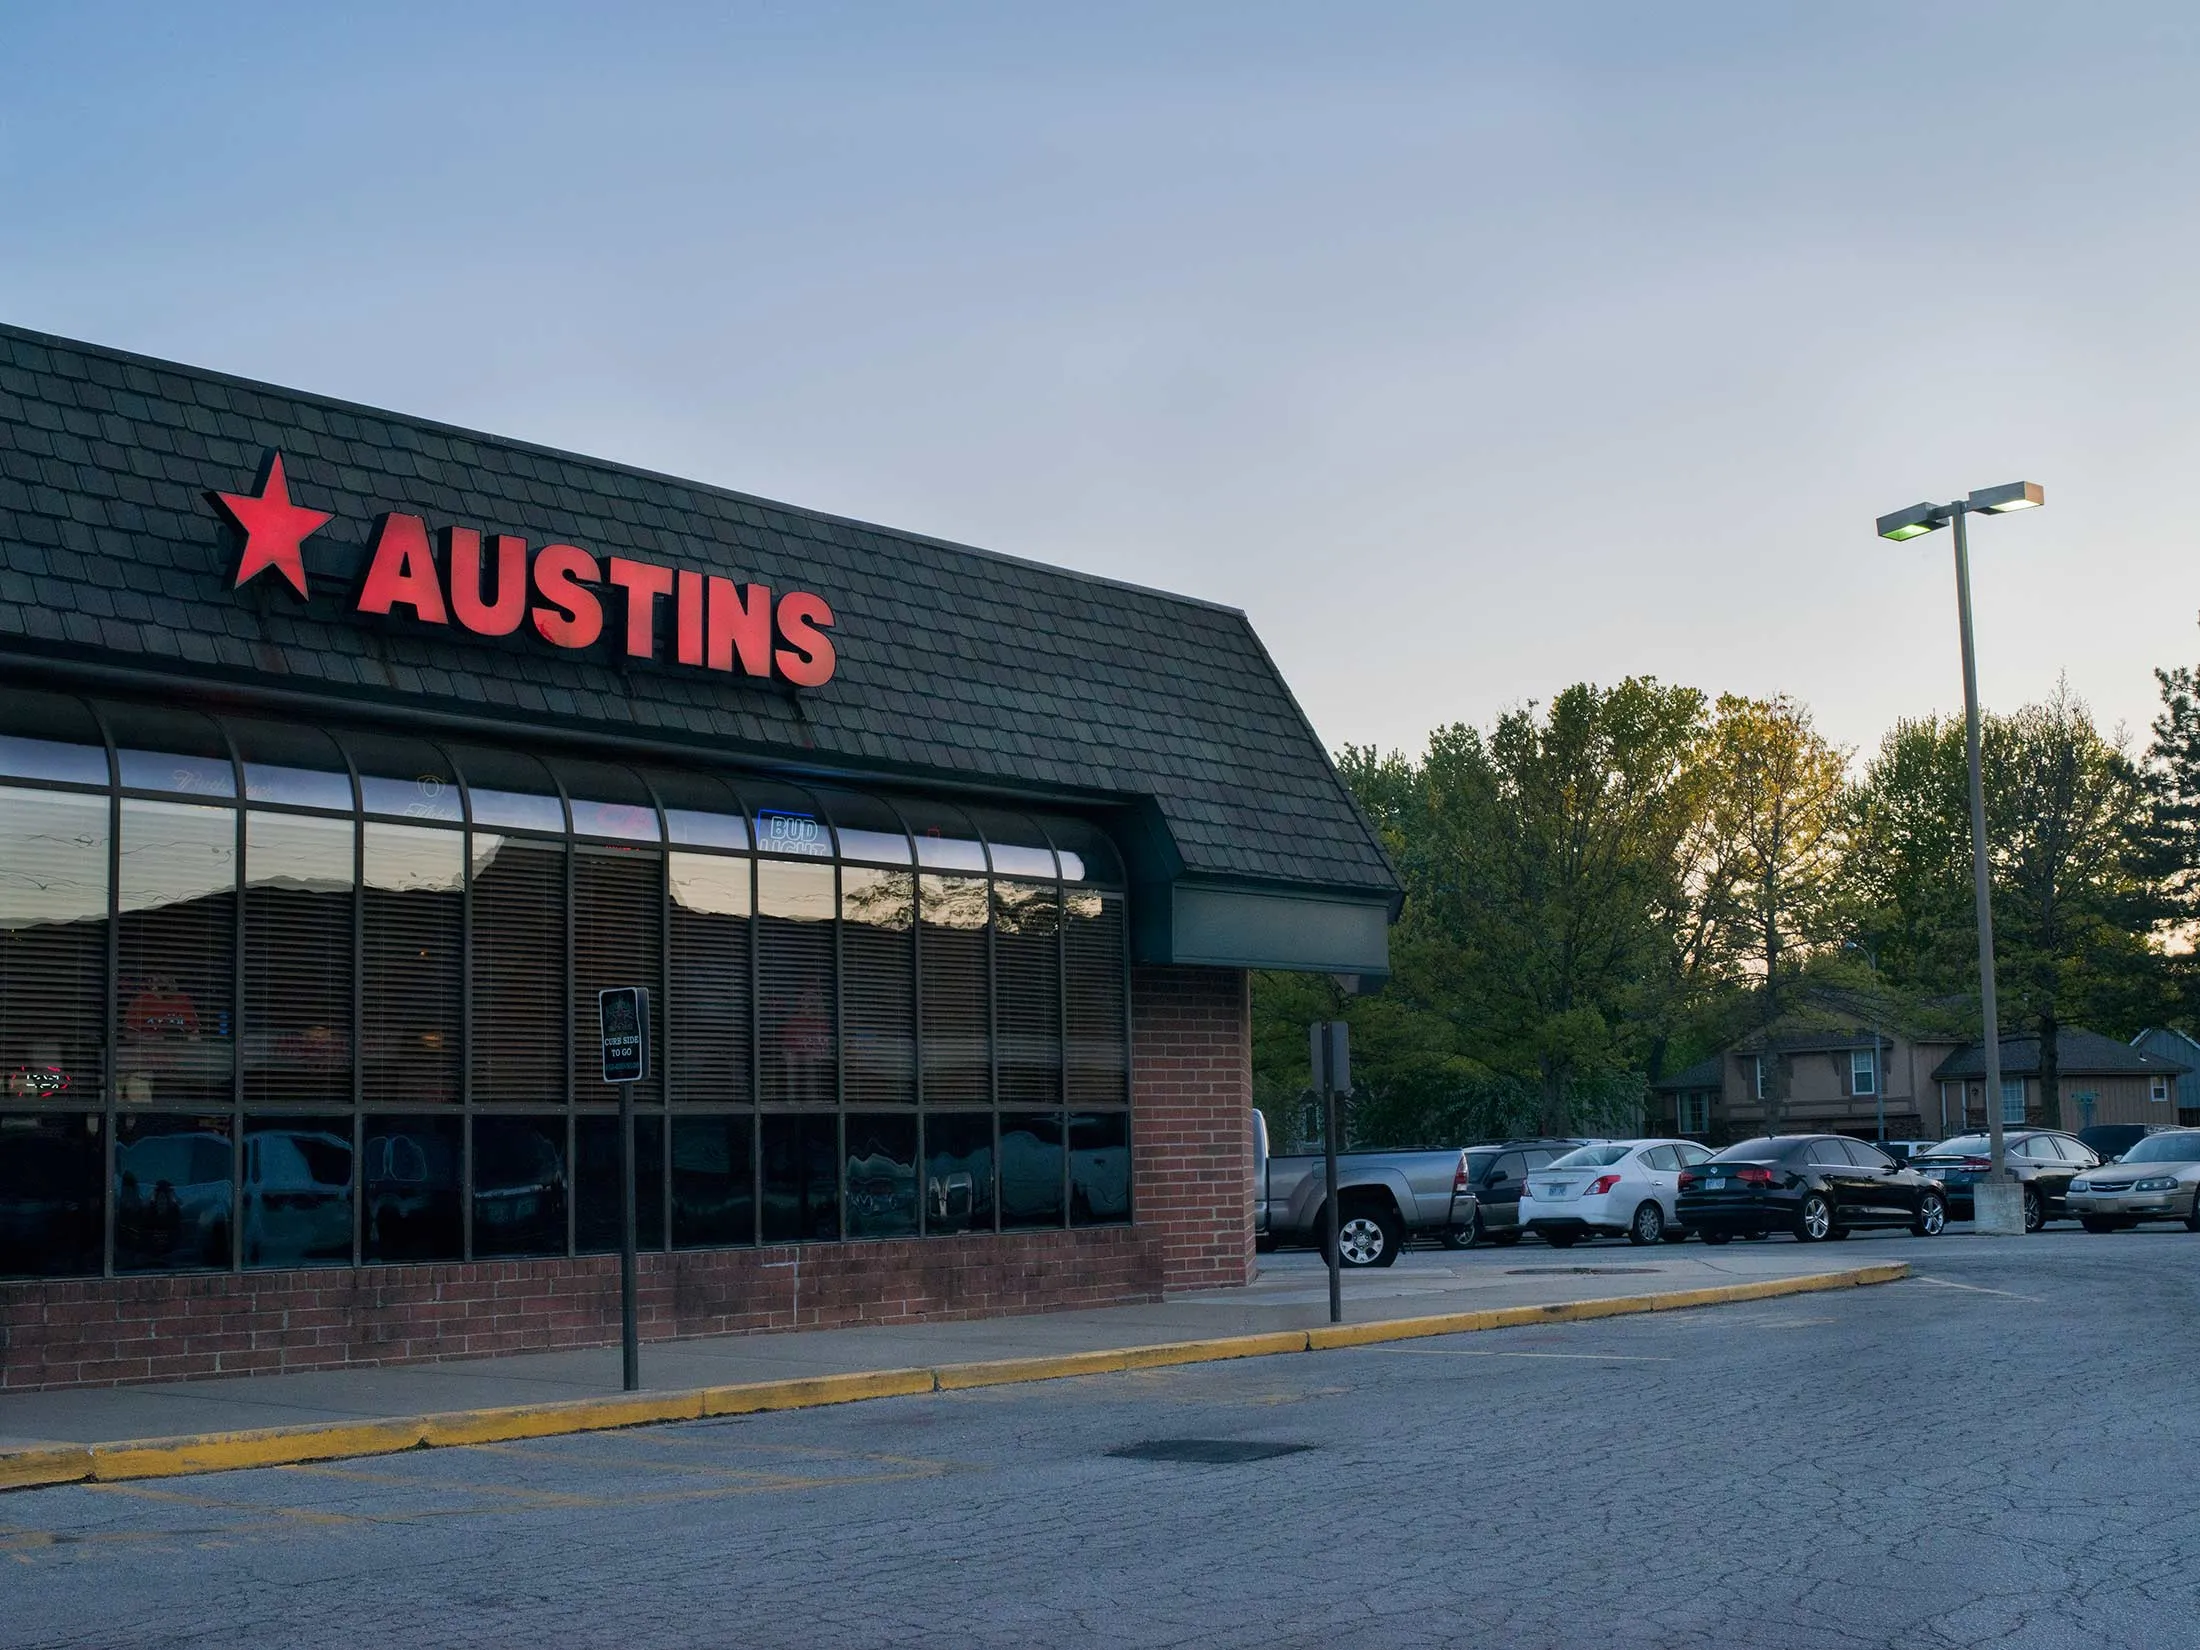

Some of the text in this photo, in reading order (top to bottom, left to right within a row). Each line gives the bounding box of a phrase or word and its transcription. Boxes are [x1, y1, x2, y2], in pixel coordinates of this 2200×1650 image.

[356, 511, 837, 689] AUSTINS
[770, 816, 818, 842] BUD
[604, 1036, 639, 1046] CURB SIDE
[611, 1048, 632, 1057] TO GO
